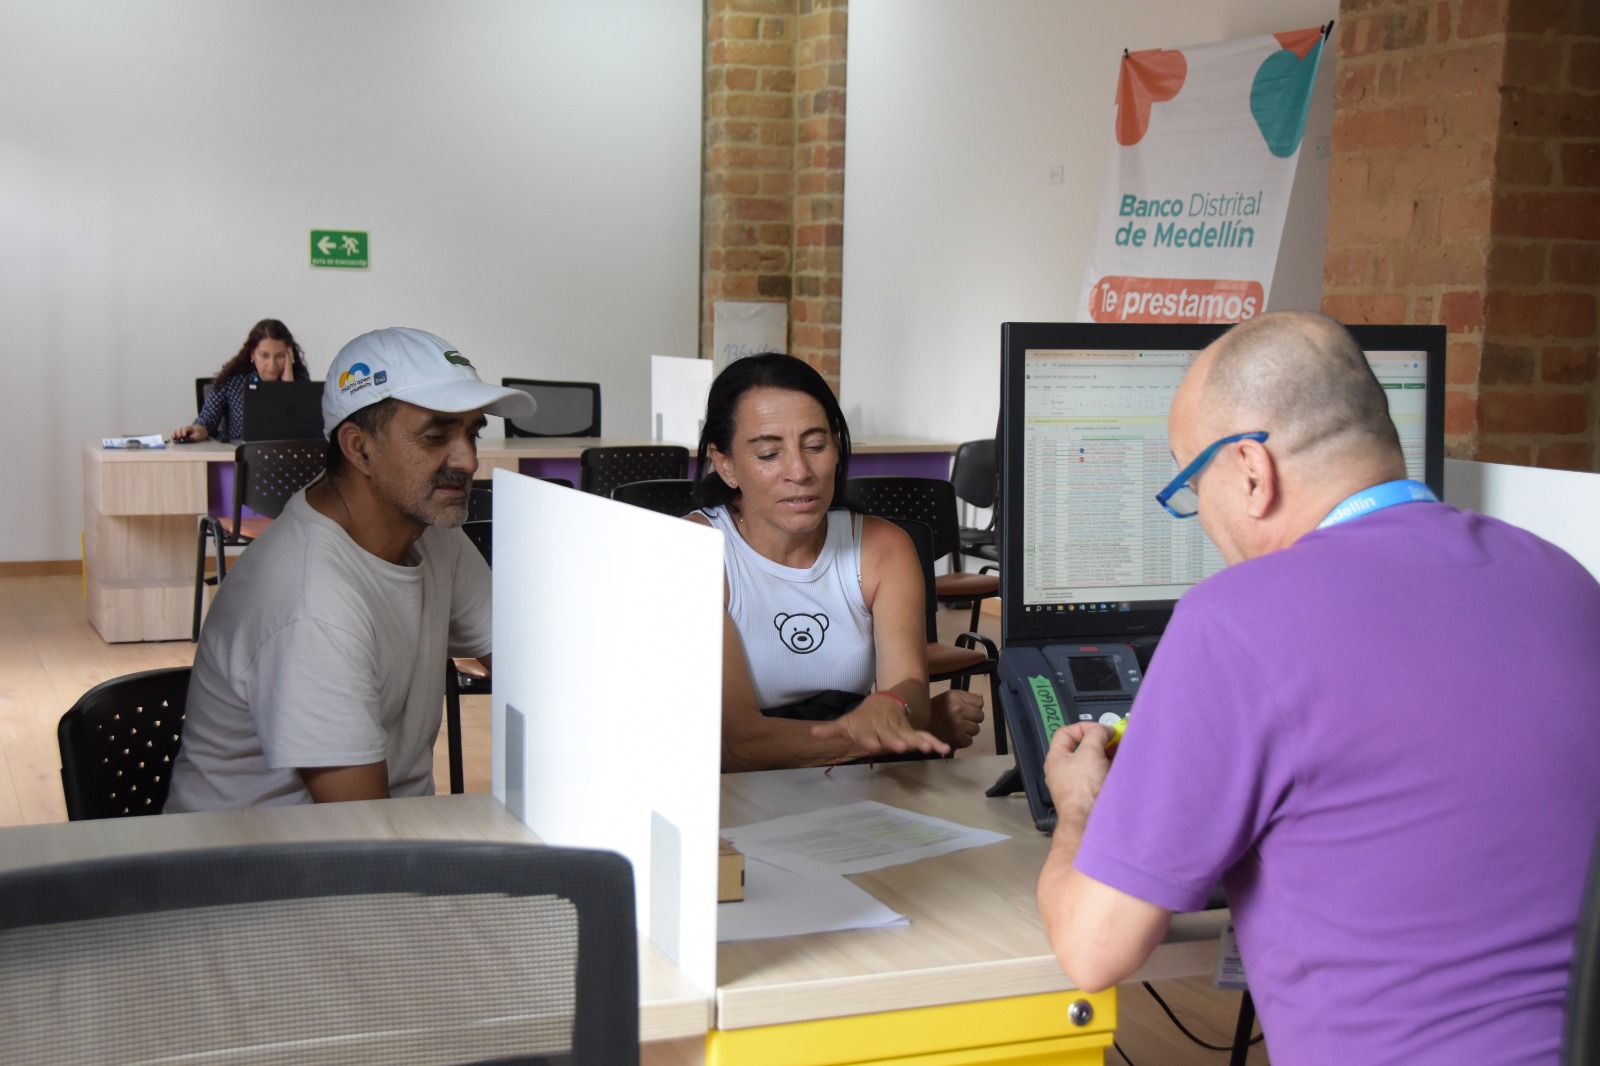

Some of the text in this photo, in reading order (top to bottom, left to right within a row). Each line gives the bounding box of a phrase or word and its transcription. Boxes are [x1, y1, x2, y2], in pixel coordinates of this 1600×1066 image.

[1119, 191, 1263, 217] Banco Distrital
[1115, 219, 1255, 248] de Medellín
[1101, 282, 1257, 320] Te prestamos
[341, 377, 371, 392] miami open
